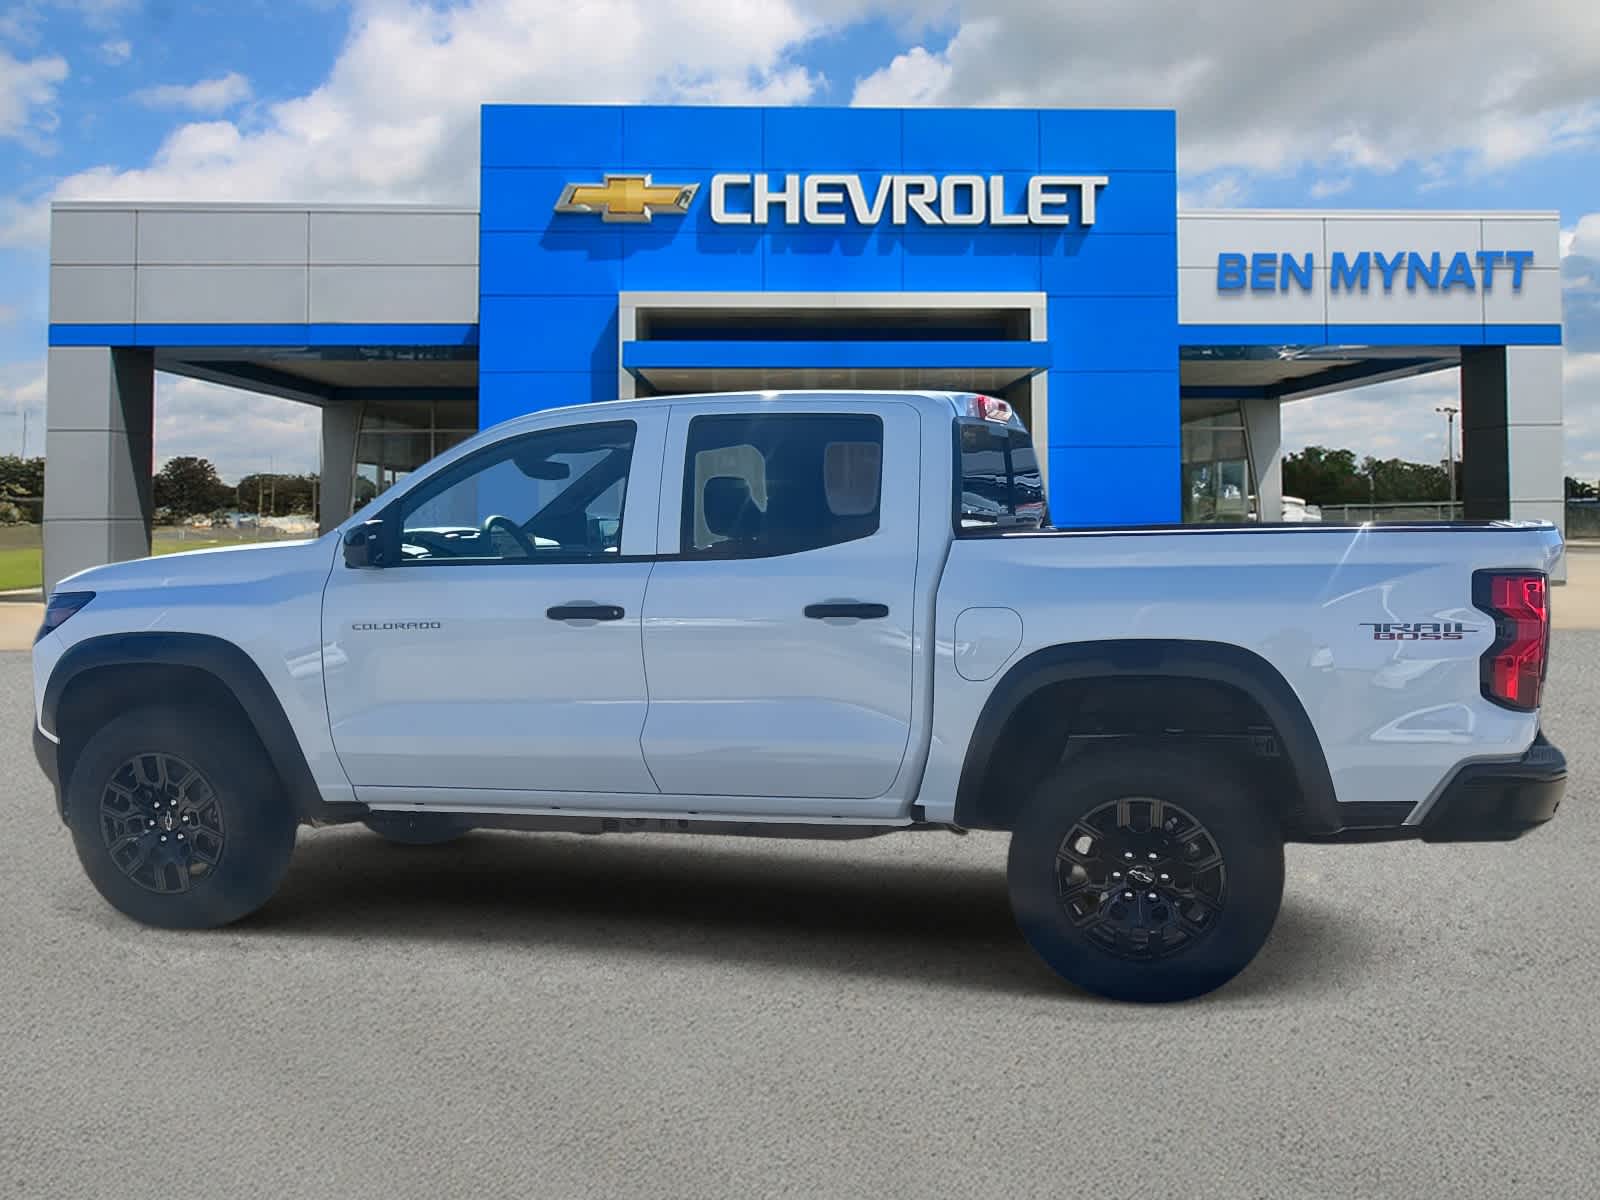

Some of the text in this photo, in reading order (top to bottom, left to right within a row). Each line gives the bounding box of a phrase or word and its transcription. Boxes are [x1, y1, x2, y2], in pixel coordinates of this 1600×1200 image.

[710, 173, 1109, 225] CHEVROLET
[1217, 251, 1533, 290] BEN MYNATT
[352, 621, 441, 631] COLORADO
[1359, 623, 1479, 632] TRAIL
[1373, 632, 1464, 640] BOSS
